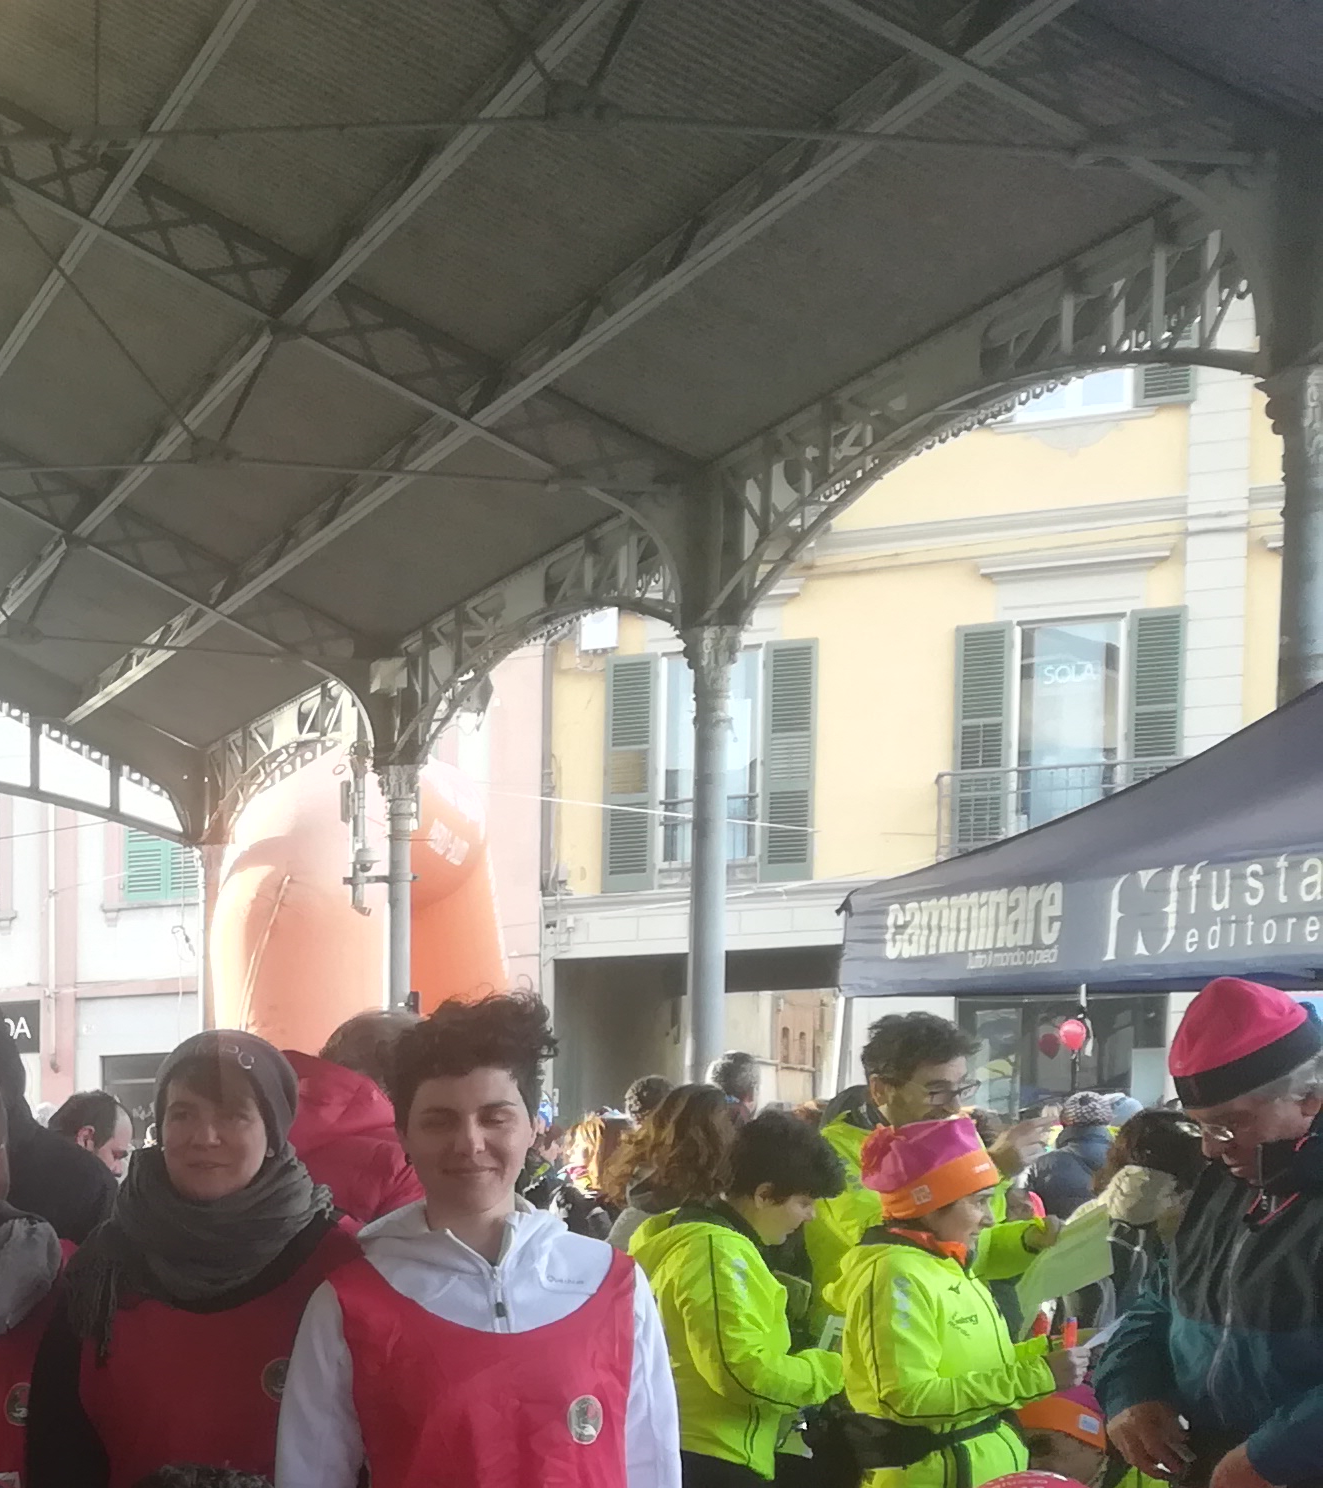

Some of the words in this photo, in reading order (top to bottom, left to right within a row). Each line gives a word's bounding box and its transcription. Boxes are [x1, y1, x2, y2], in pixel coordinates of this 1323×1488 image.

[1188, 852, 1323, 915] fusta
[884, 881, 1064, 960] camminare
[1185, 914, 1322, 953] editore
